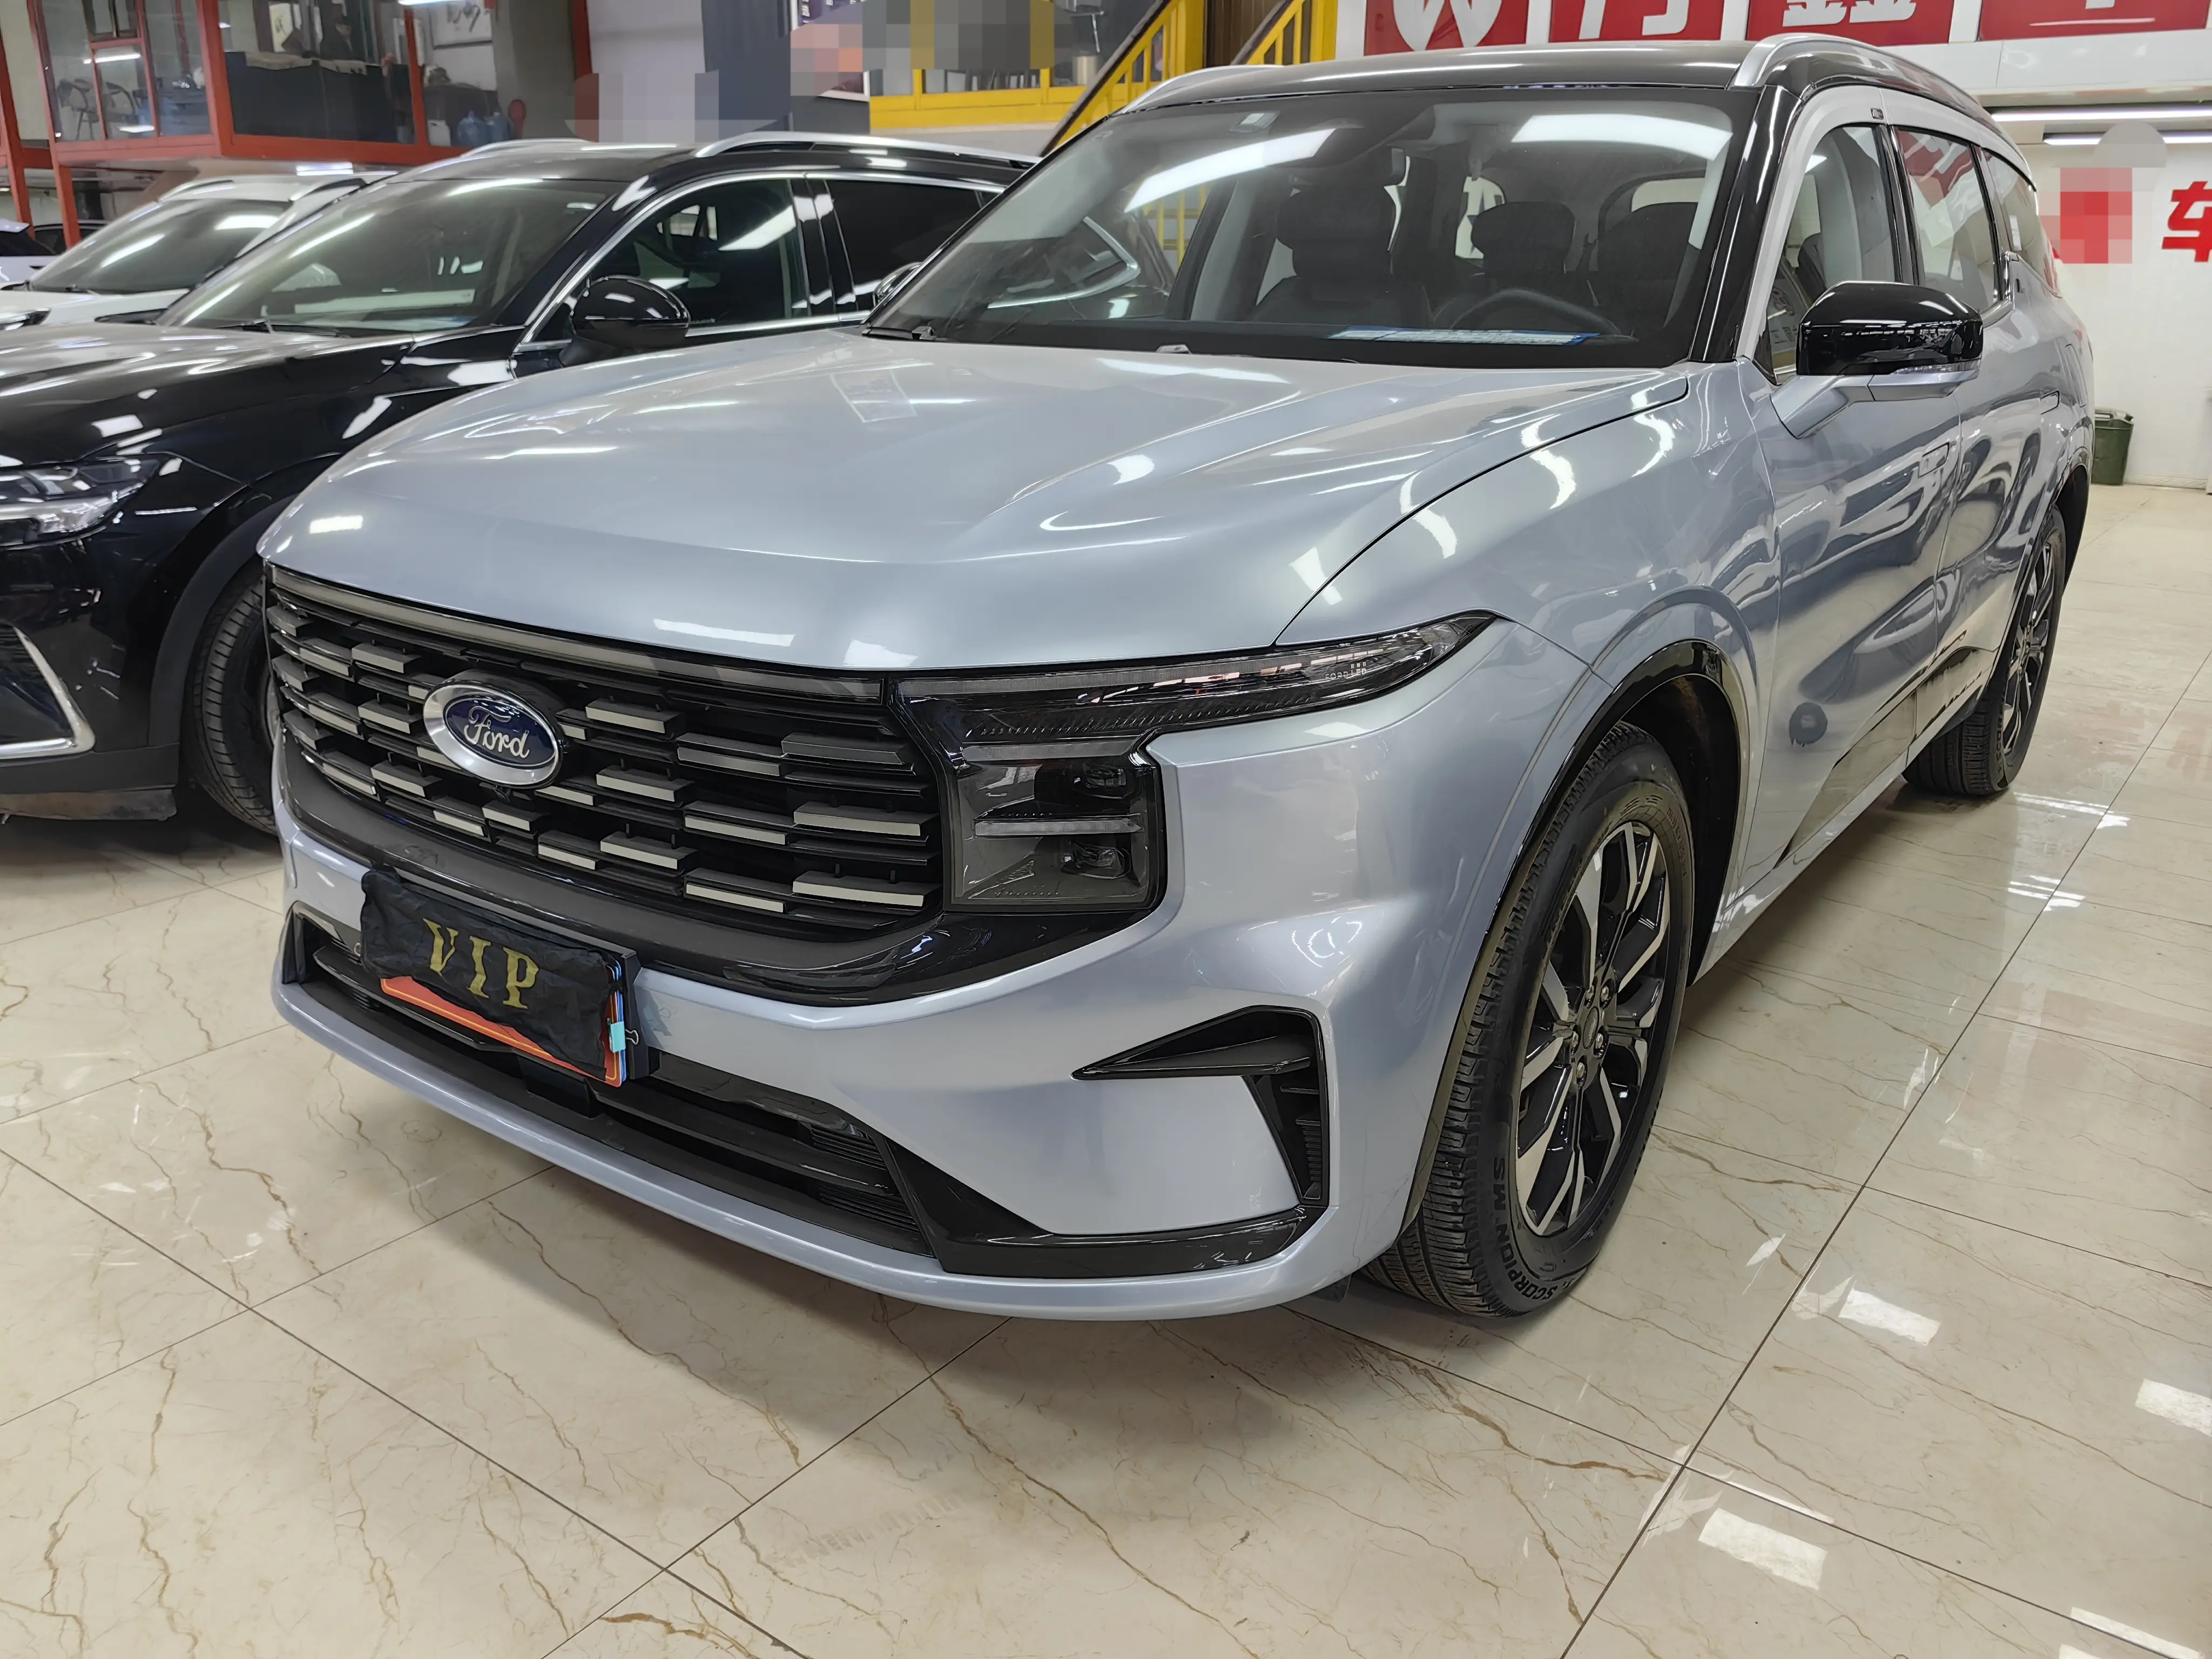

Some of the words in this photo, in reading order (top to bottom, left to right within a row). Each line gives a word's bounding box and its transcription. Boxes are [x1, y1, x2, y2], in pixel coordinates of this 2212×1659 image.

[463, 705, 530, 758] Ford
[424, 919, 539, 1009] VIP
[1493, 1157, 1506, 1211] MS
[1496, 1223, 1557, 1300] SCORPION
